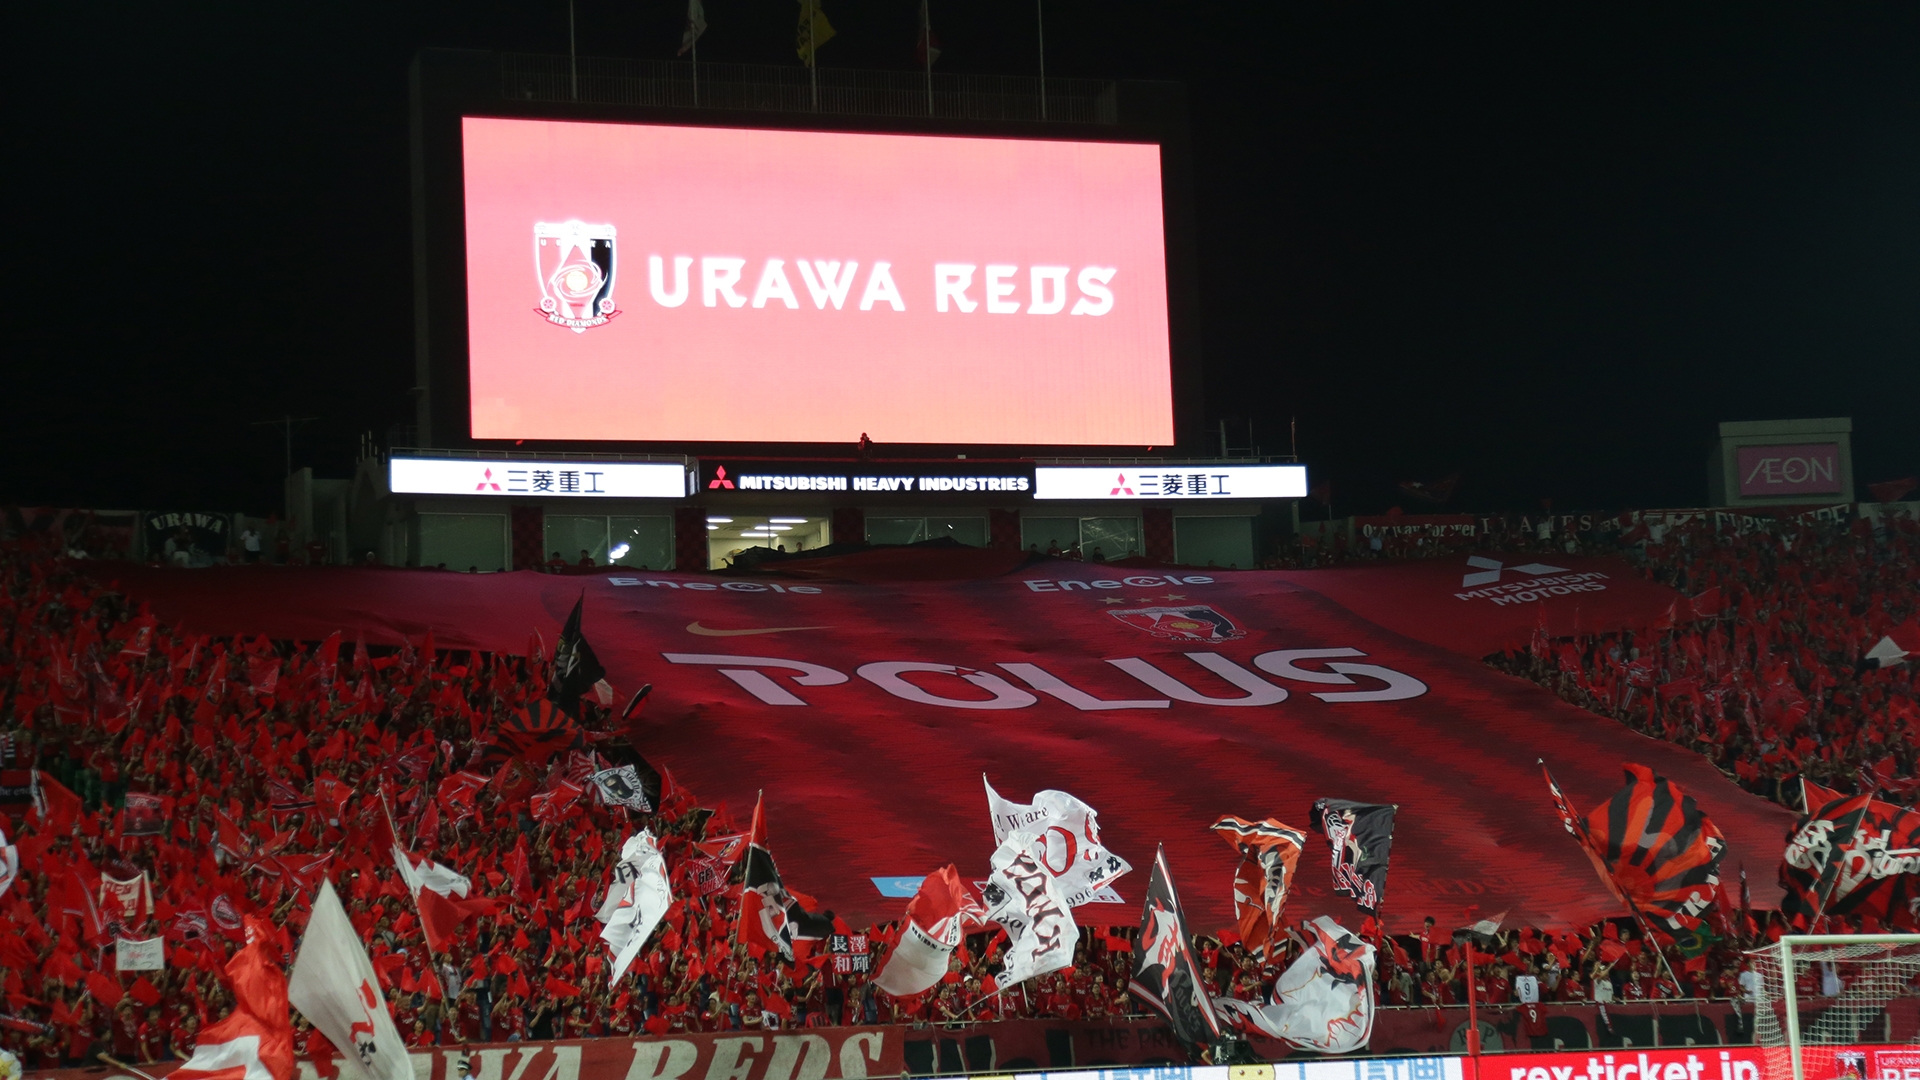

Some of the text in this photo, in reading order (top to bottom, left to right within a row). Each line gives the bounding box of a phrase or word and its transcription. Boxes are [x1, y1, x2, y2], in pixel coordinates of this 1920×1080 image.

[648, 255, 1117, 316] URAWA REDS
[507, 470, 605, 493] 三菱重工
[739, 475, 1029, 491] MITSUBISHI HEAVY INDUSTRIES
[1139, 474, 1231, 495] 三菱重工
[150, 513, 224, 534] URAWA
[1453, 571, 1610, 601] MITSUBISHI
[1489, 581, 1607, 606] MOTORS
[662, 647, 1428, 711] POLUS
[832, 935, 866, 952] 長澤
[833, 956, 869, 973] 和輝
[1524, 982, 1531, 996] 9
[1529, 1009, 1537, 1023] 9
[625, 1031, 884, 1080] REDS
